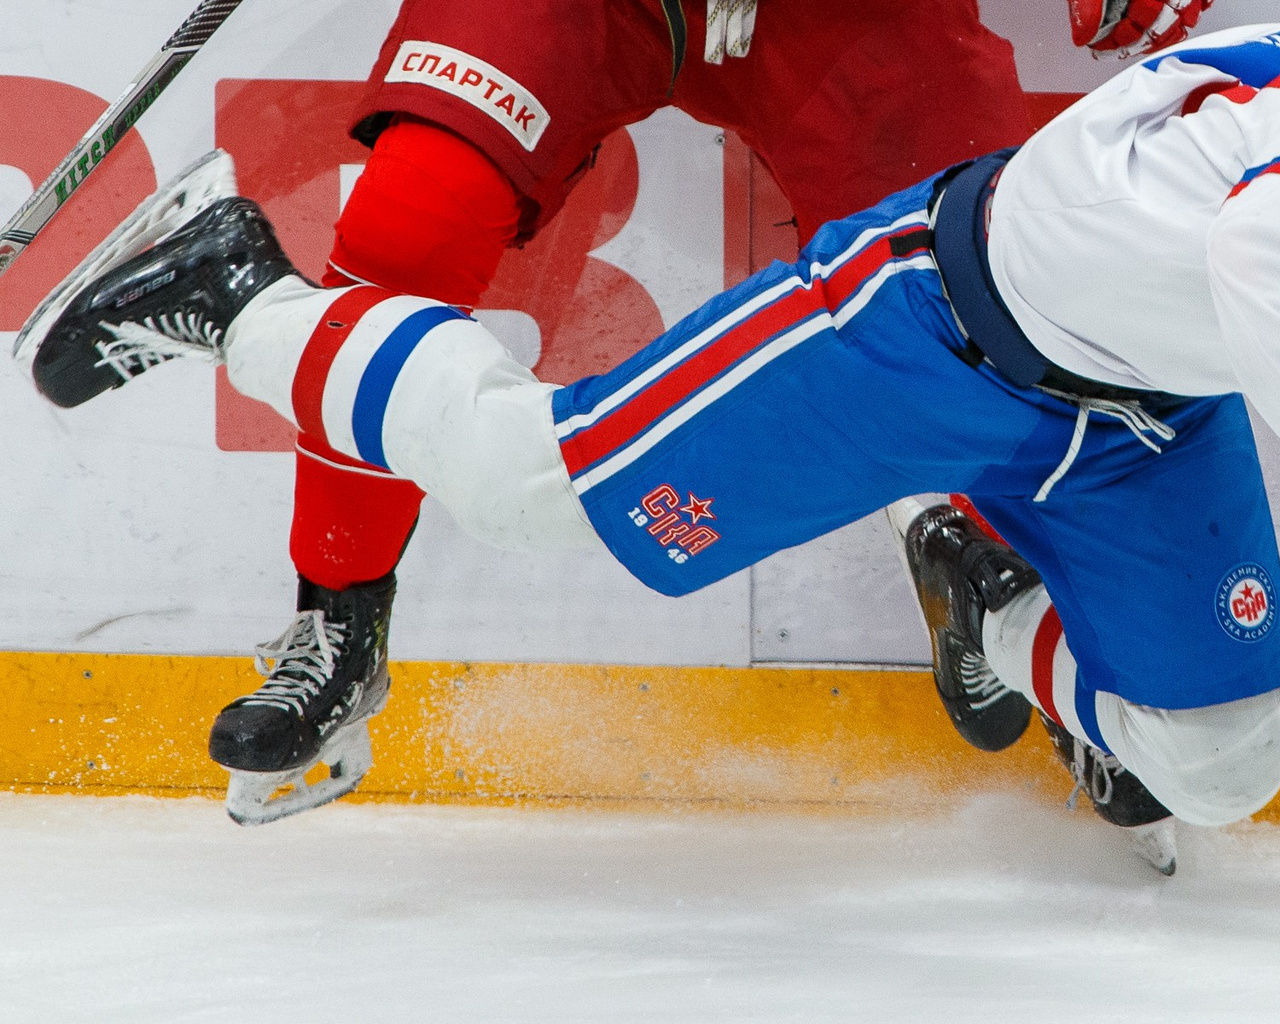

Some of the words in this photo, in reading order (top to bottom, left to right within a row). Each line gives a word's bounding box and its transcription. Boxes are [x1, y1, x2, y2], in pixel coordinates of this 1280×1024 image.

[402, 51, 537, 132] СПАРТАК
[627, 507, 649, 527] 19
[667, 548, 689, 564] 46
[641, 483, 722, 556] СКА
[1232, 589, 1267, 623] СКА
